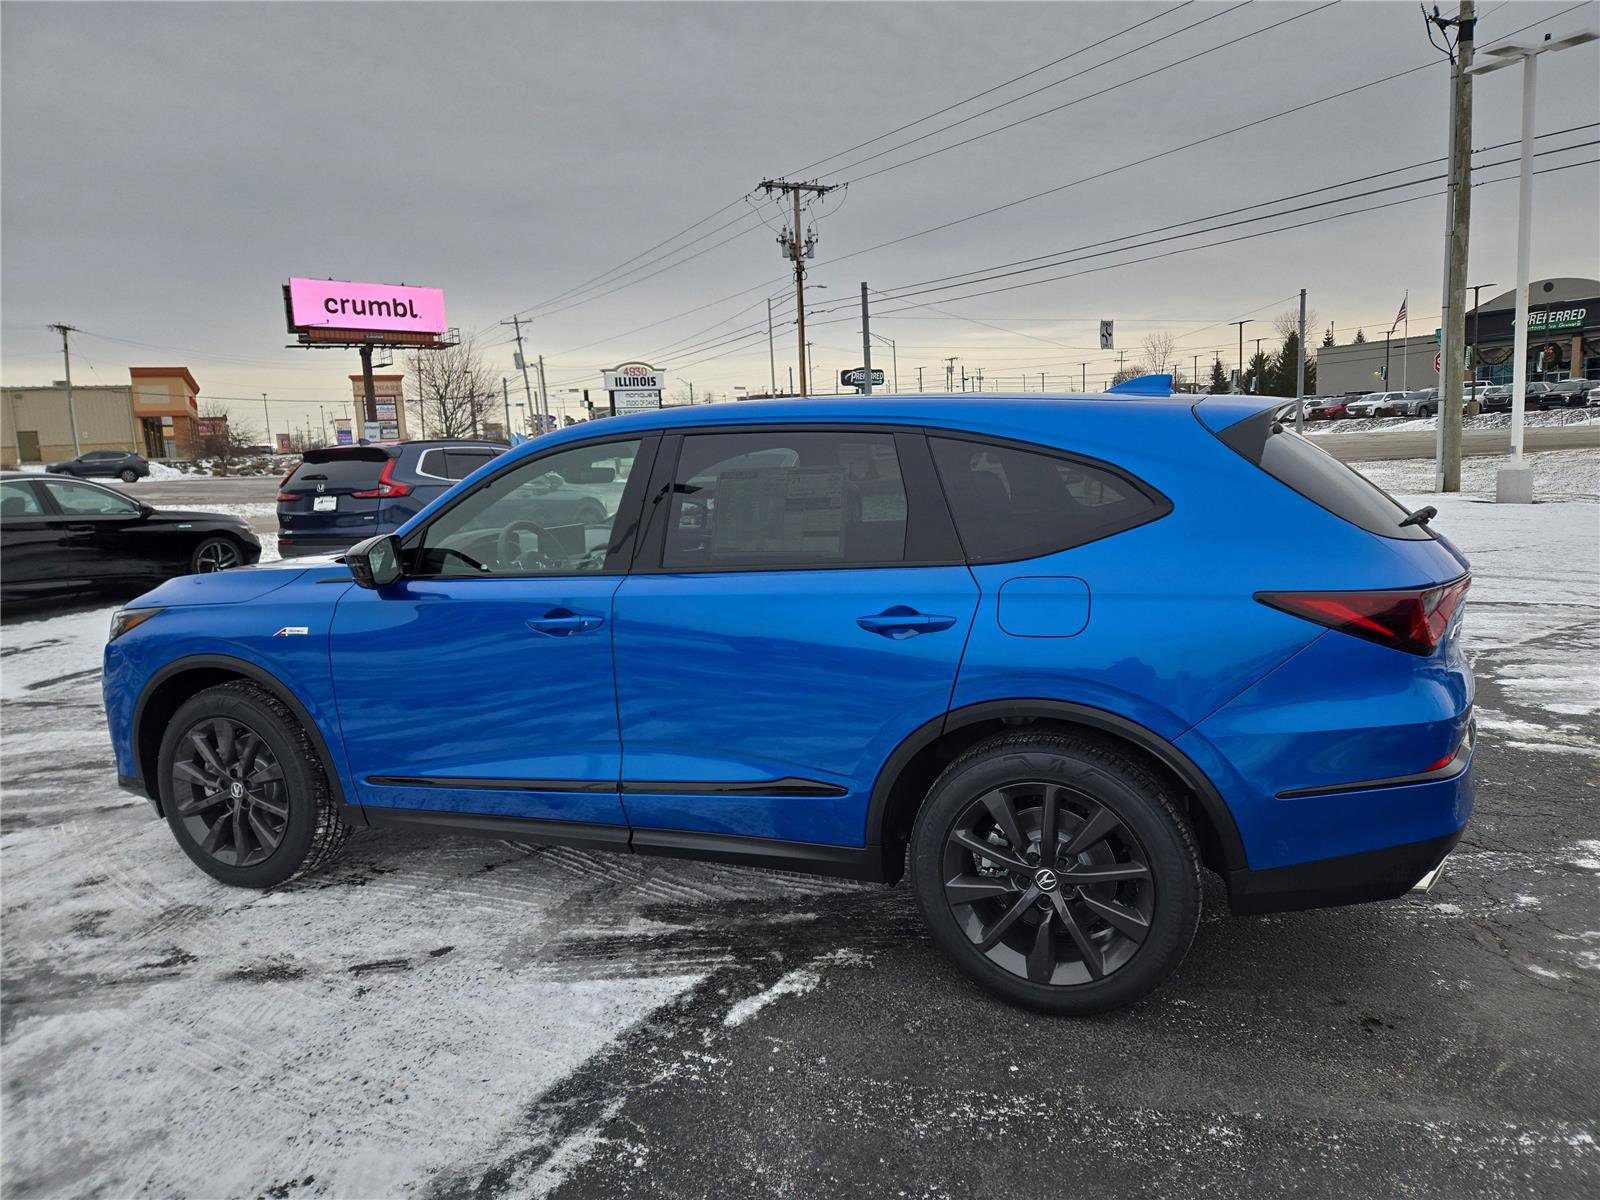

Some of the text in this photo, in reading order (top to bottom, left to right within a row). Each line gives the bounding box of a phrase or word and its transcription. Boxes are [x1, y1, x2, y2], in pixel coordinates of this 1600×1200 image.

[1527, 308, 1586, 324] REFERRED
[624, 367, 647, 376] 4930
[614, 376, 656, 387] ILLINOIS
